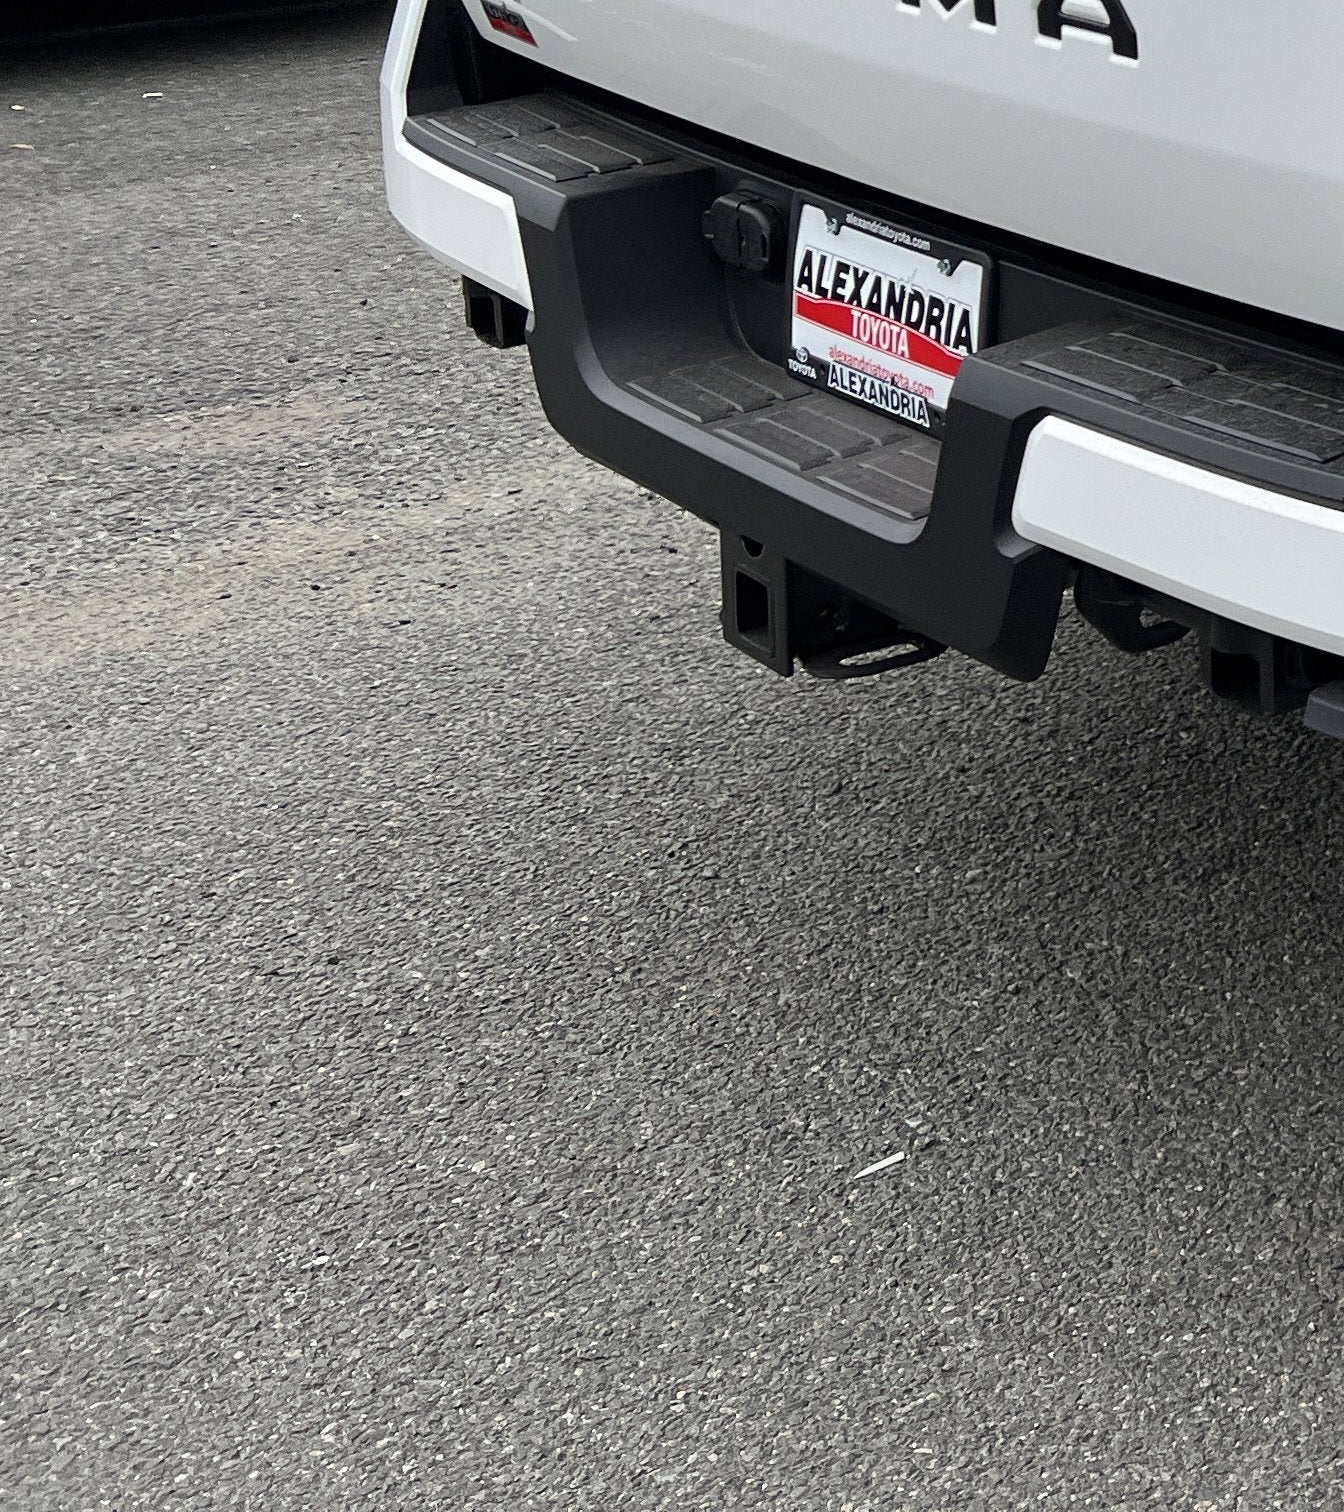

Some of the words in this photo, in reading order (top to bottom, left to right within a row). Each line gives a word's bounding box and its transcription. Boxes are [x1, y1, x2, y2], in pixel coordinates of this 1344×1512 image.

[846, 212, 931, 251] alexandriatoyota.com
[796, 249, 974, 354] ALEXANDRIA
[850, 308, 911, 359] TOYOTA
[788, 358, 817, 380] TOYOTA
[827, 361, 931, 428] ALEXANDRIA
[828, 345, 935, 399] alexandriatoyota.com
